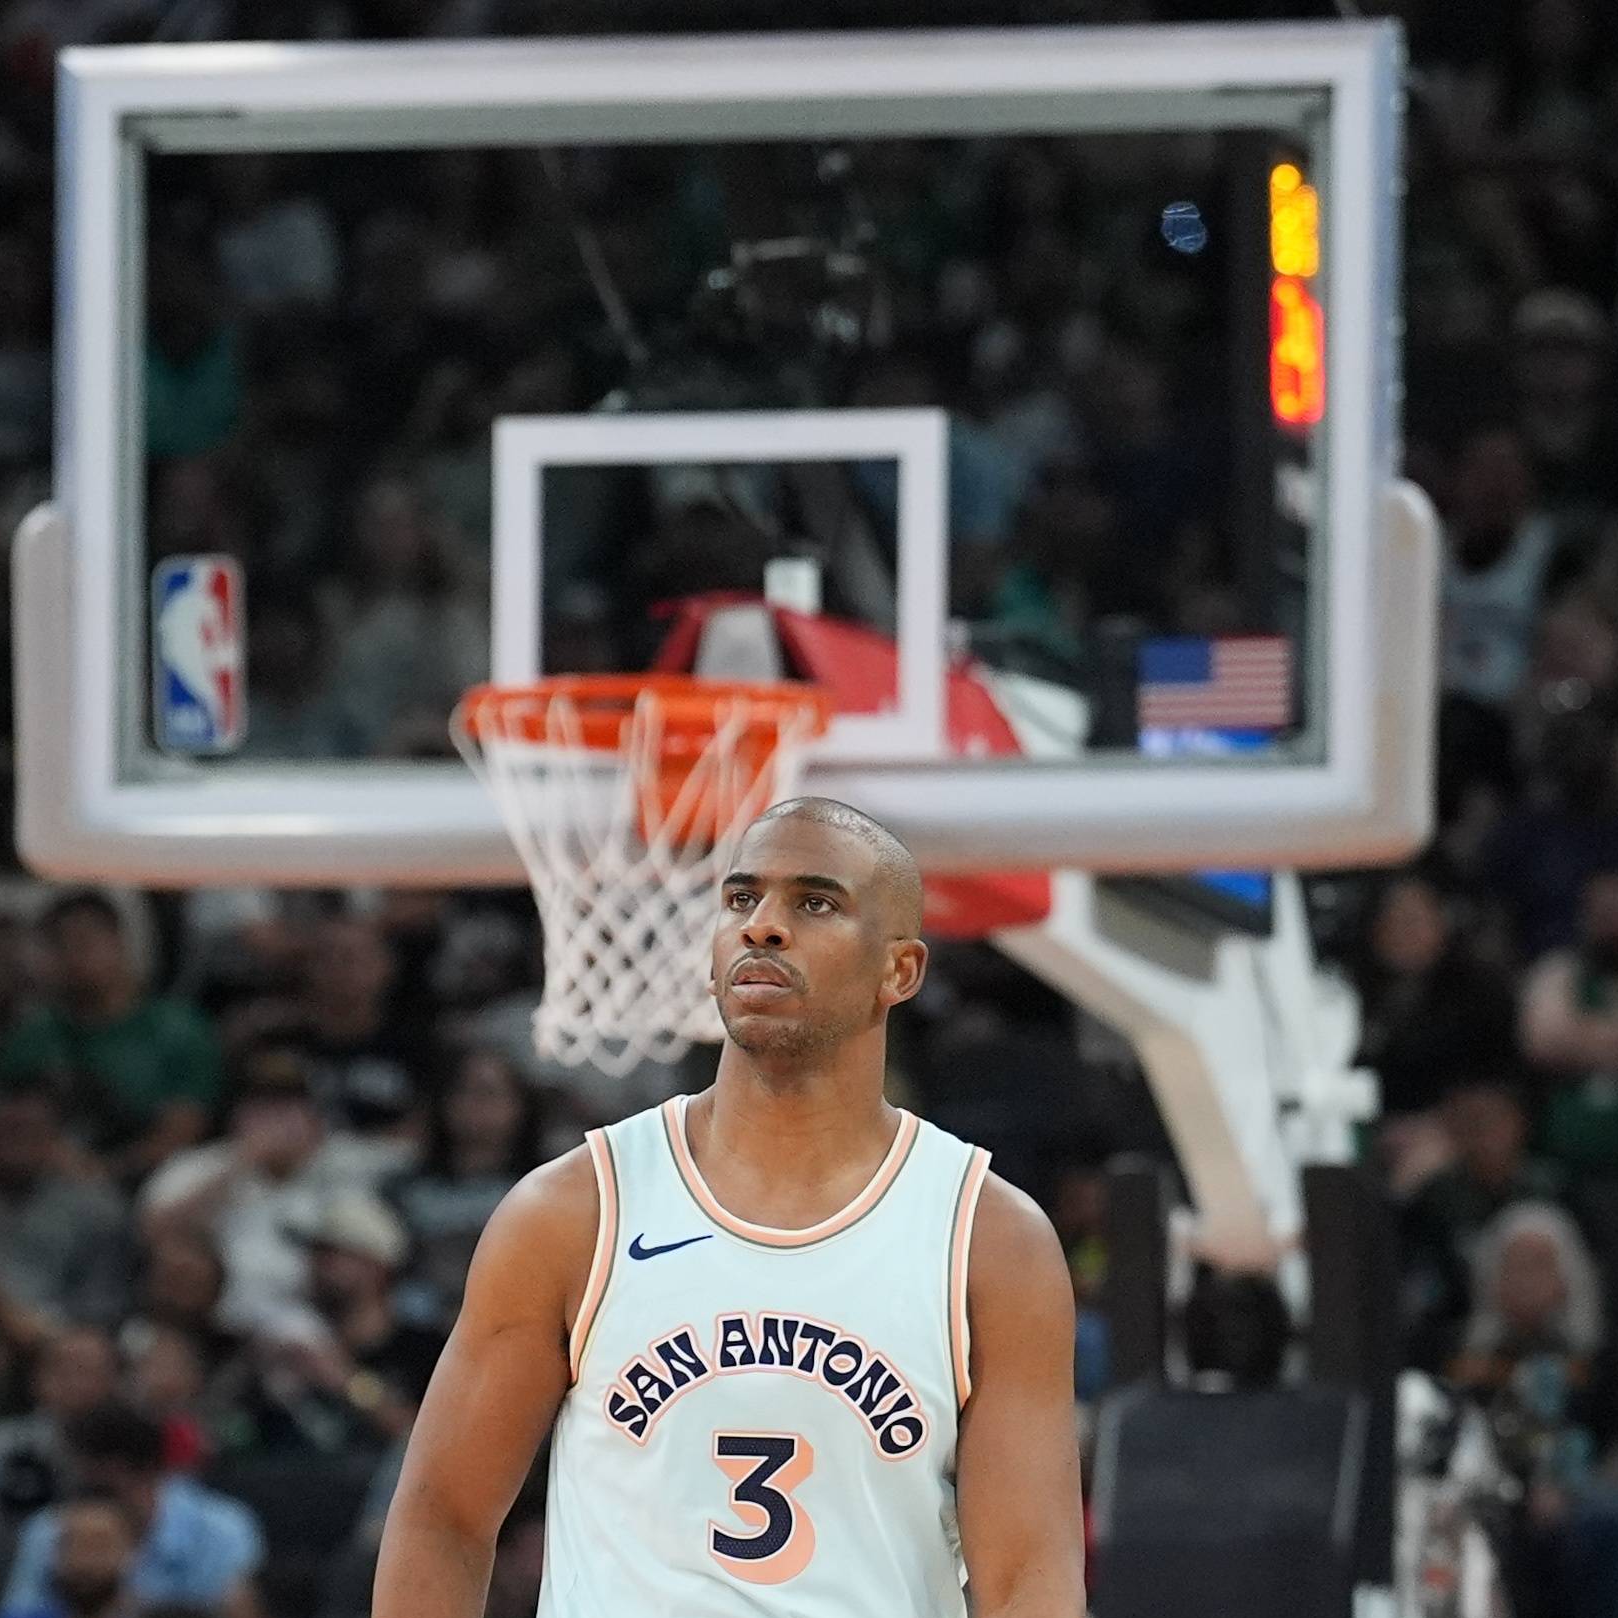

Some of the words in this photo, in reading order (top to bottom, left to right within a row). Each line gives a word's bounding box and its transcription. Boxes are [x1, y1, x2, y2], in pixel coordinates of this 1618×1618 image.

[606, 1328, 709, 1441] SAN
[714, 1315, 926, 1459] ANTONIO
[709, 1431, 801, 1568] 3
